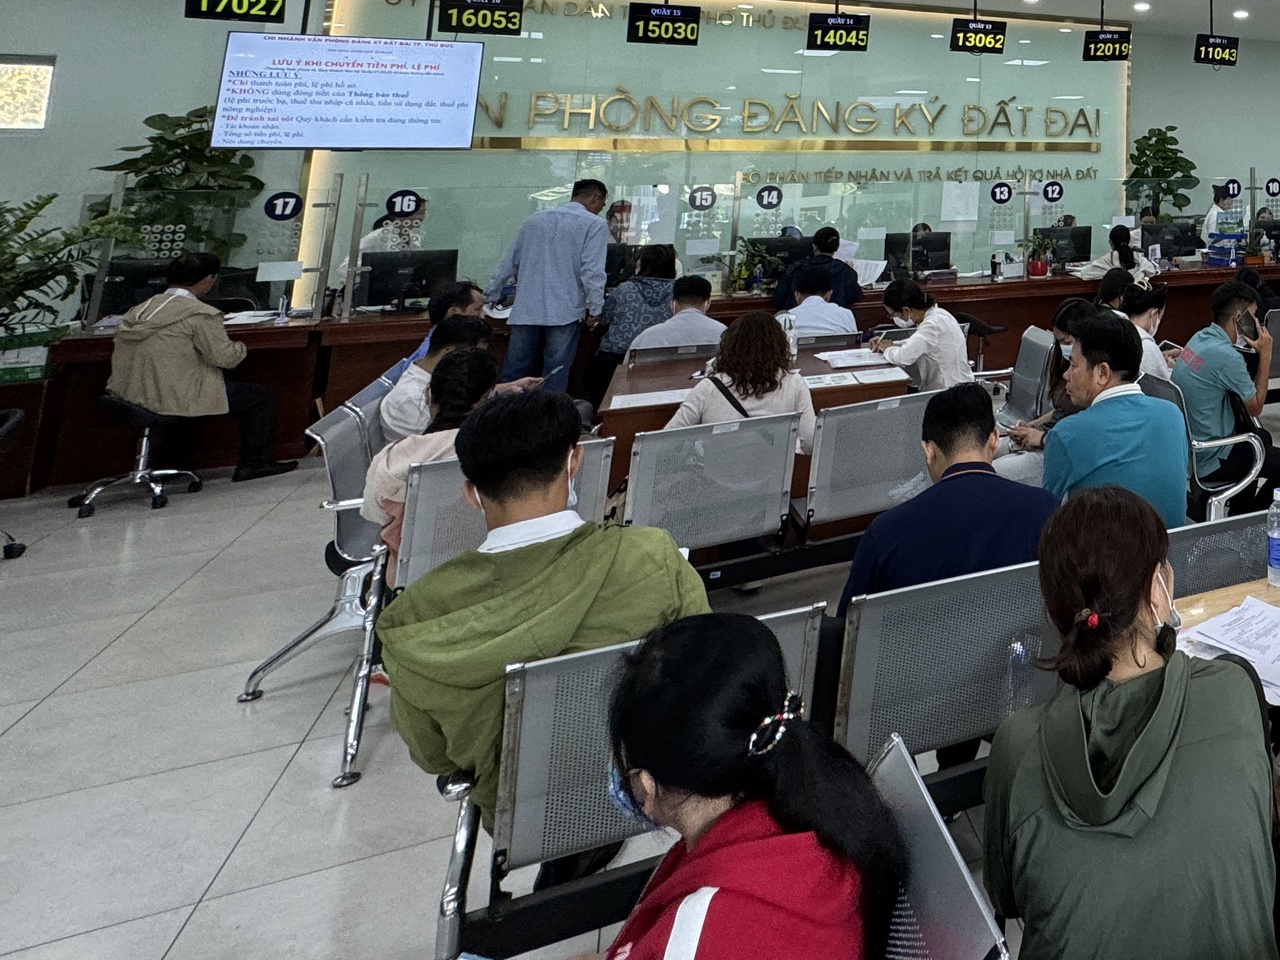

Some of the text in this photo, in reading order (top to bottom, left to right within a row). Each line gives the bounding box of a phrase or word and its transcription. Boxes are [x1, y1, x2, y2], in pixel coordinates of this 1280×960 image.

[650, 7, 673, 16] QUẦY
[447, 8, 521, 30] 16053
[740, 9, 776, 29] THỦ
[827, 17, 846, 25] QUẦY
[969, 22, 985, 30] QUẦY
[635, 21, 698, 40] 15030
[814, 29, 868, 46] 14045
[956, 32, 1004, 49] 13062
[1088, 43, 1129, 56] 12019
[1199, 46, 1237, 61] 11043
[272, 58, 293, 66] LƯU
[295, 58, 302, 66] Ý
[411, 62, 422, 71] LỆ
[424, 62, 440, 71] PHÍ
[228, 70, 267, 78] NHỮNG
[269, 70, 290, 78] LƯU
[311, 80, 319, 89] lệ
[334, 80, 345, 88] hồ
[240, 114, 265, 122] tránh
[528, 85, 722, 132] PHÒNG
[742, 92, 880, 134] ĐĂNG
[894, 95, 947, 135] KÝ
[962, 95, 1033, 136] ĐẤT
[1045, 106, 1101, 137] ĐAI
[814, 166, 844, 183] TIẾP
[893, 167, 914, 181] VÀ
[918, 166, 942, 181] TRẢ
[946, 165, 970, 181] KẾT
[972, 166, 1001, 181] QUẢ
[1046, 167, 1071, 181] NHÀ
[1075, 166, 1099, 181] ĐẤT
[994, 187, 1009, 200] 13
[1046, 185, 1060, 198] 12
[1227, 182, 1238, 195] 11
[1268, 181, 1280, 194] 10
[392, 195, 417, 213] 16
[693, 191, 712, 206] 15
[761, 190, 779, 205] 14
[273, 197, 297, 216] 17
